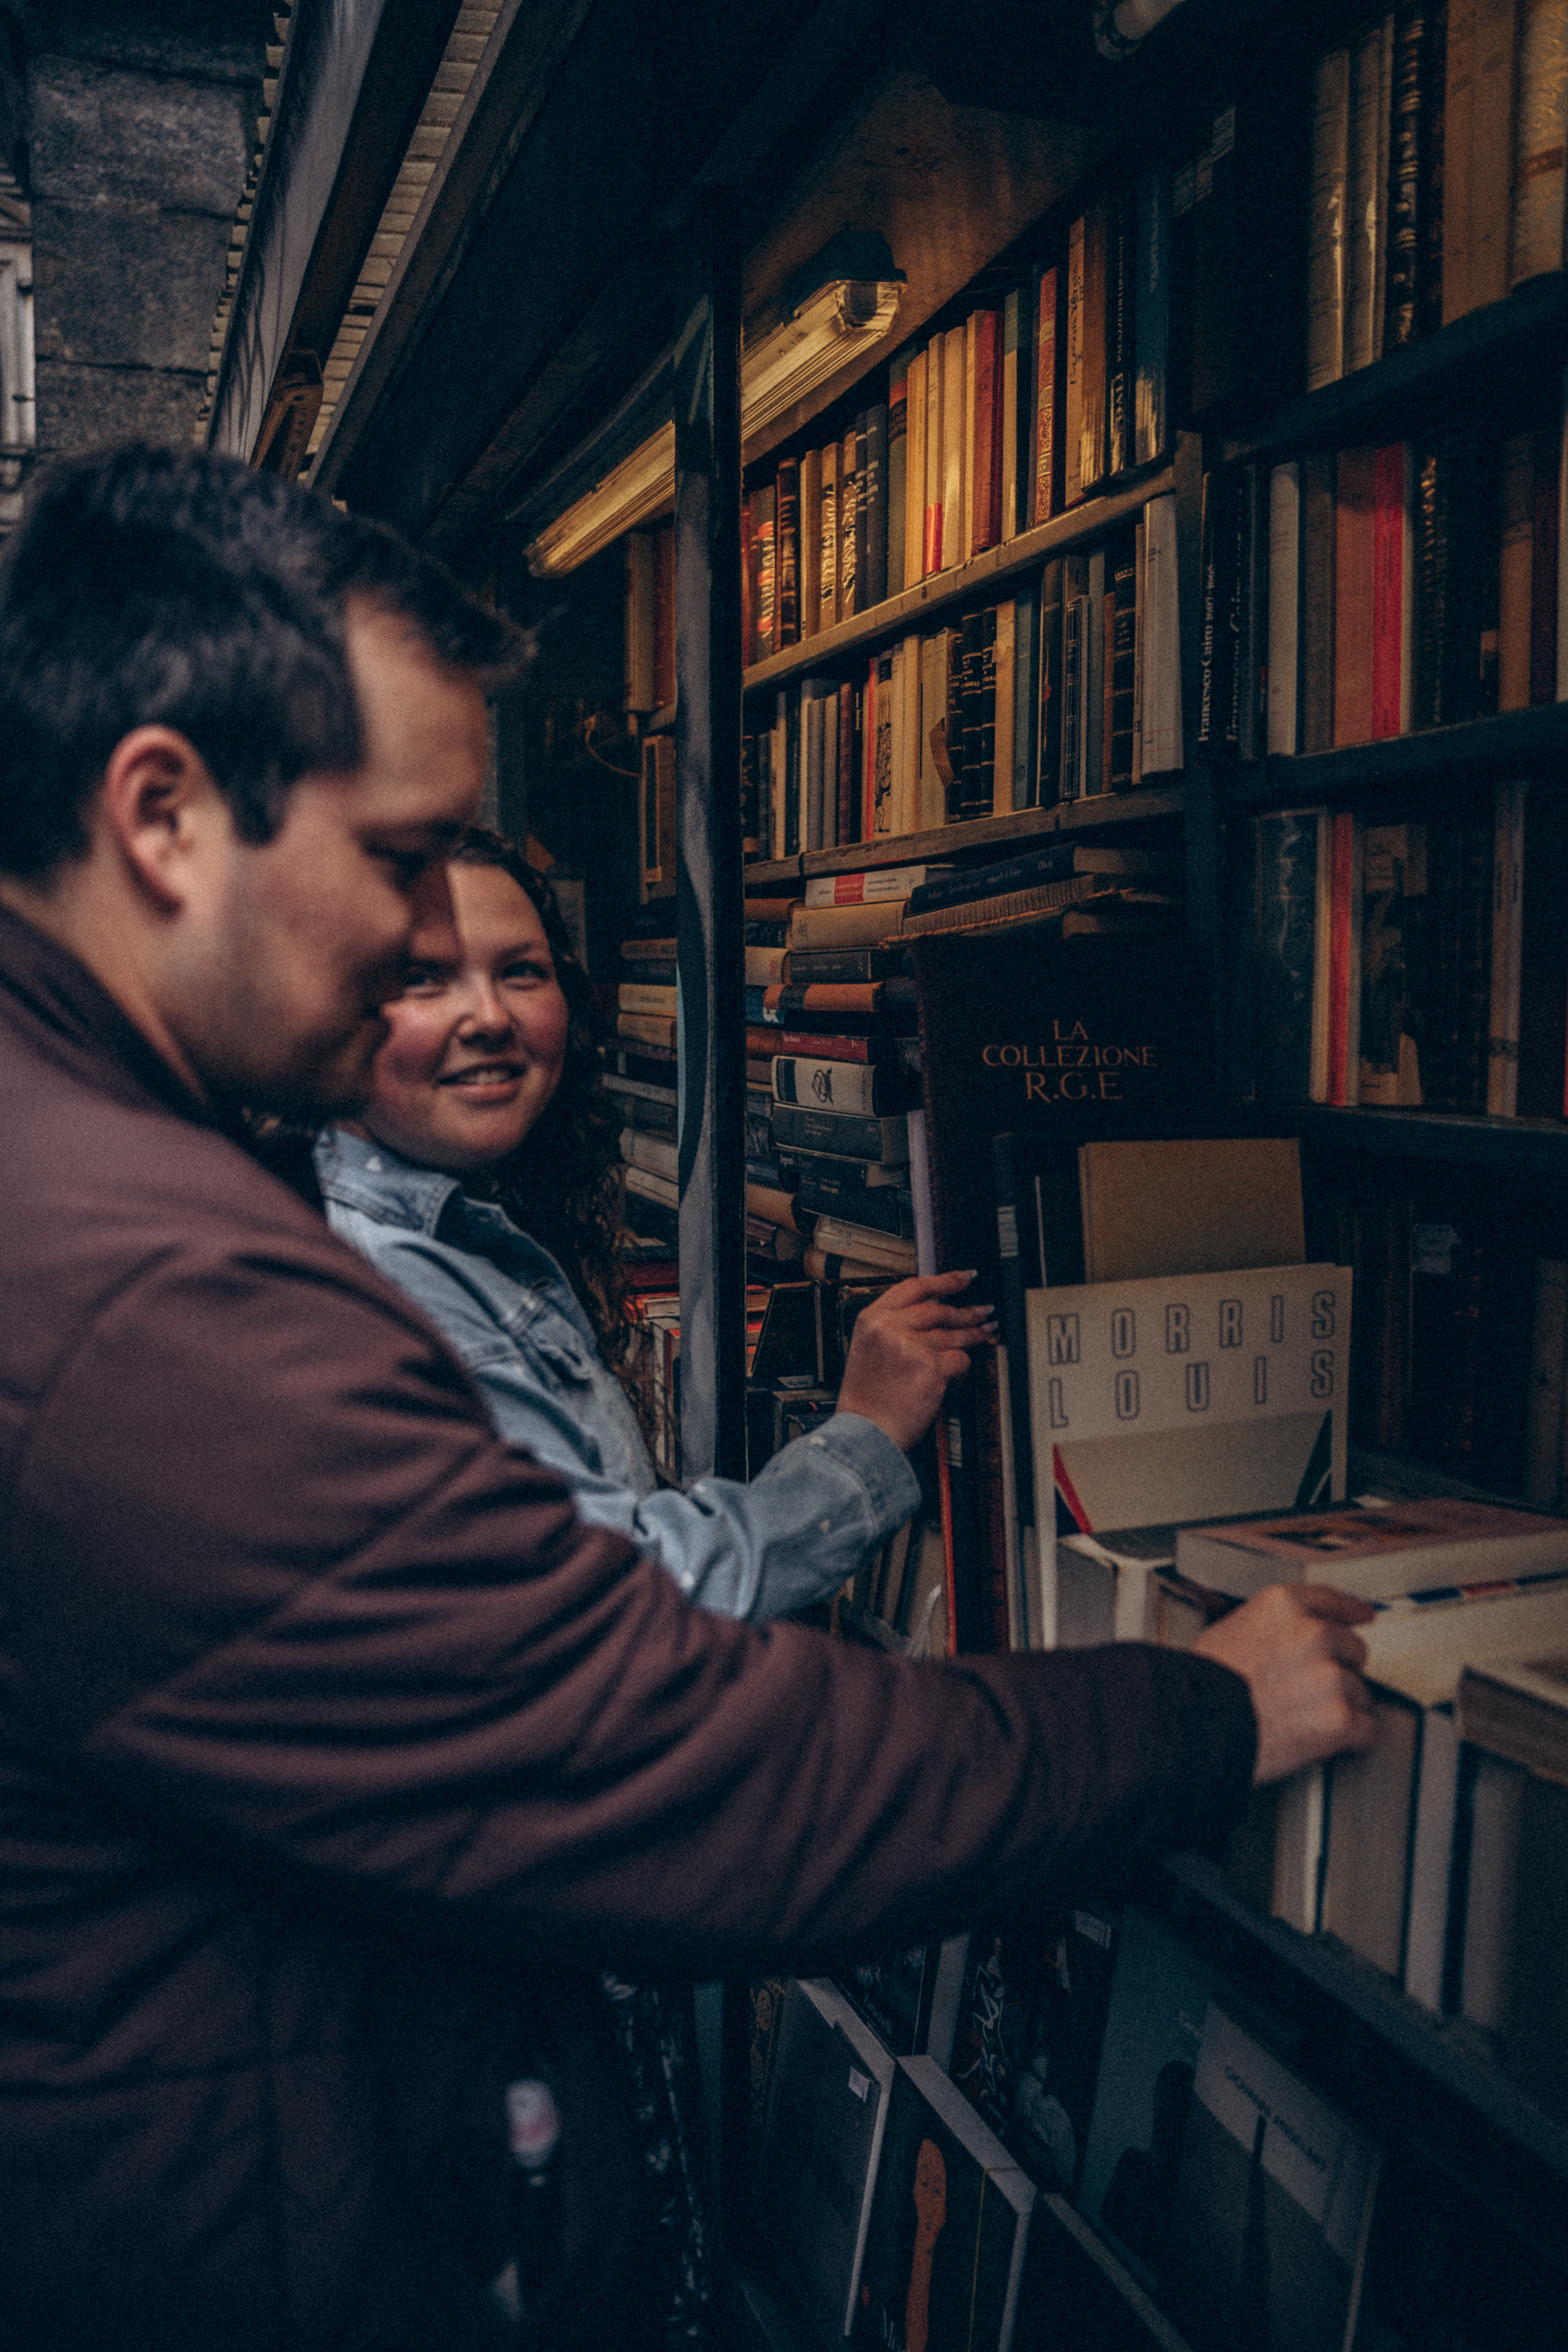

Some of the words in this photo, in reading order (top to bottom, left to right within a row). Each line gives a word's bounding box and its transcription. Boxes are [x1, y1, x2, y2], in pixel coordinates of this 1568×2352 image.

[1200, 625, 1213, 667] Cairo
[1197, 668, 1212, 742] Francesco
[1053, 1019, 1090, 1041] LA
[981, 1044, 1158, 1068] COLLEZIONE
[1025, 1071, 1124, 1103] R.G.E
[1046, 1291, 1336, 1366] MORRIS
[1049, 1349, 1334, 1429] LOUIS
